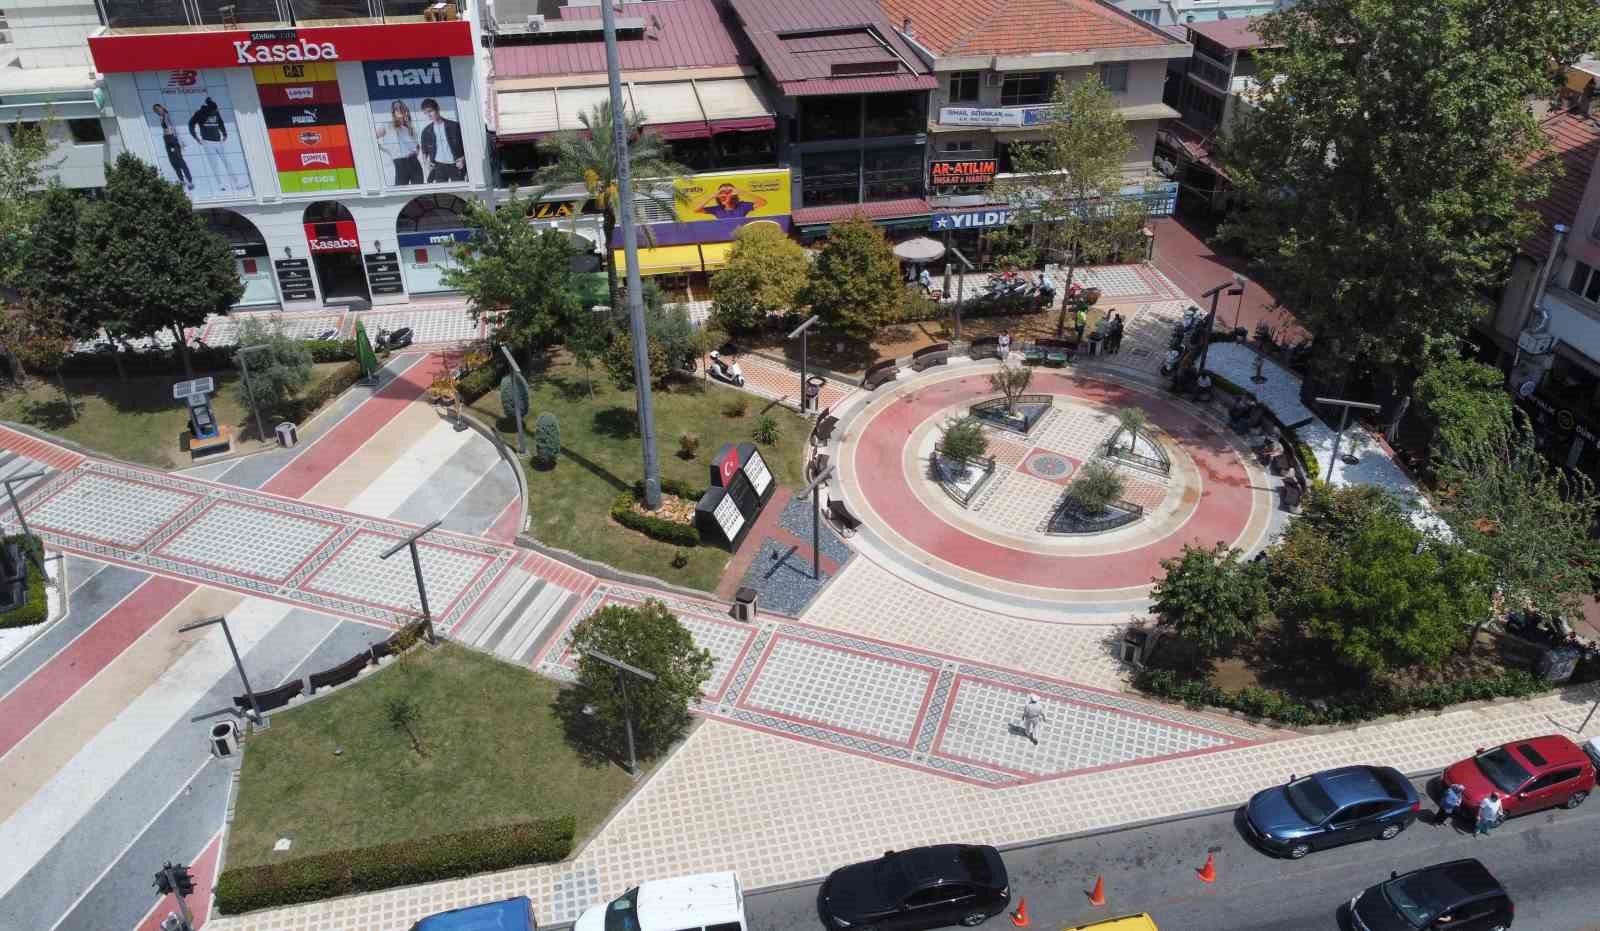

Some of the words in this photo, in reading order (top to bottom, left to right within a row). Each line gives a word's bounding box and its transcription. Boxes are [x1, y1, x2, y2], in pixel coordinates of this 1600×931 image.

[233, 38, 339, 63] Kasaba
[376, 62, 441, 86] mavi
[309, 238, 358, 250] Kasaba
